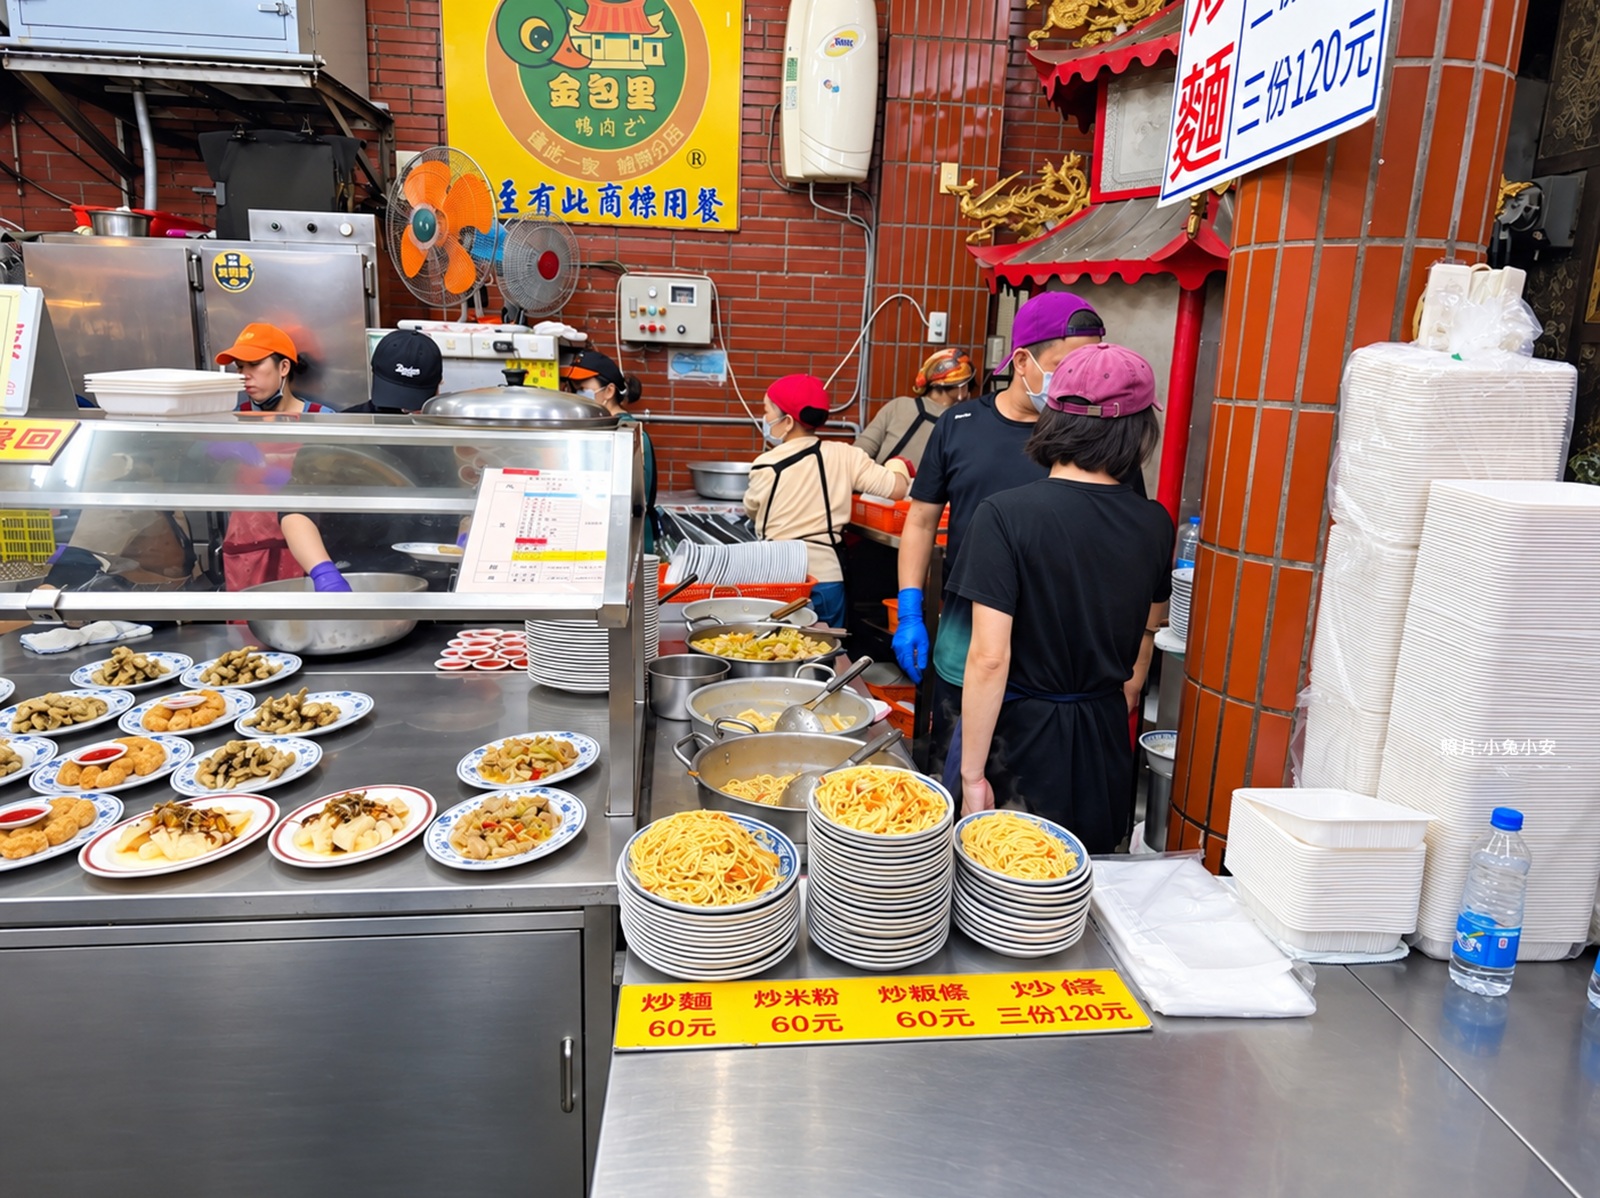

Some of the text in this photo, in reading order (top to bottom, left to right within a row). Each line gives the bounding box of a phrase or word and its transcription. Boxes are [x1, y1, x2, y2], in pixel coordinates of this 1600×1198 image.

[1237, 9, 1376, 136] 三份120元
[548, 71, 657, 112] 金包里
[499, 179, 724, 224] 至有此商標用餐
[641, 991, 712, 1012] 炒麵
[753, 987, 840, 1007] 炒米粉
[771, 1013, 844, 1033] 60元
[895, 1008, 976, 1028] 60元
[996, 1002, 1134, 1025] 三份120元
[648, 1017, 717, 1037] 60元
